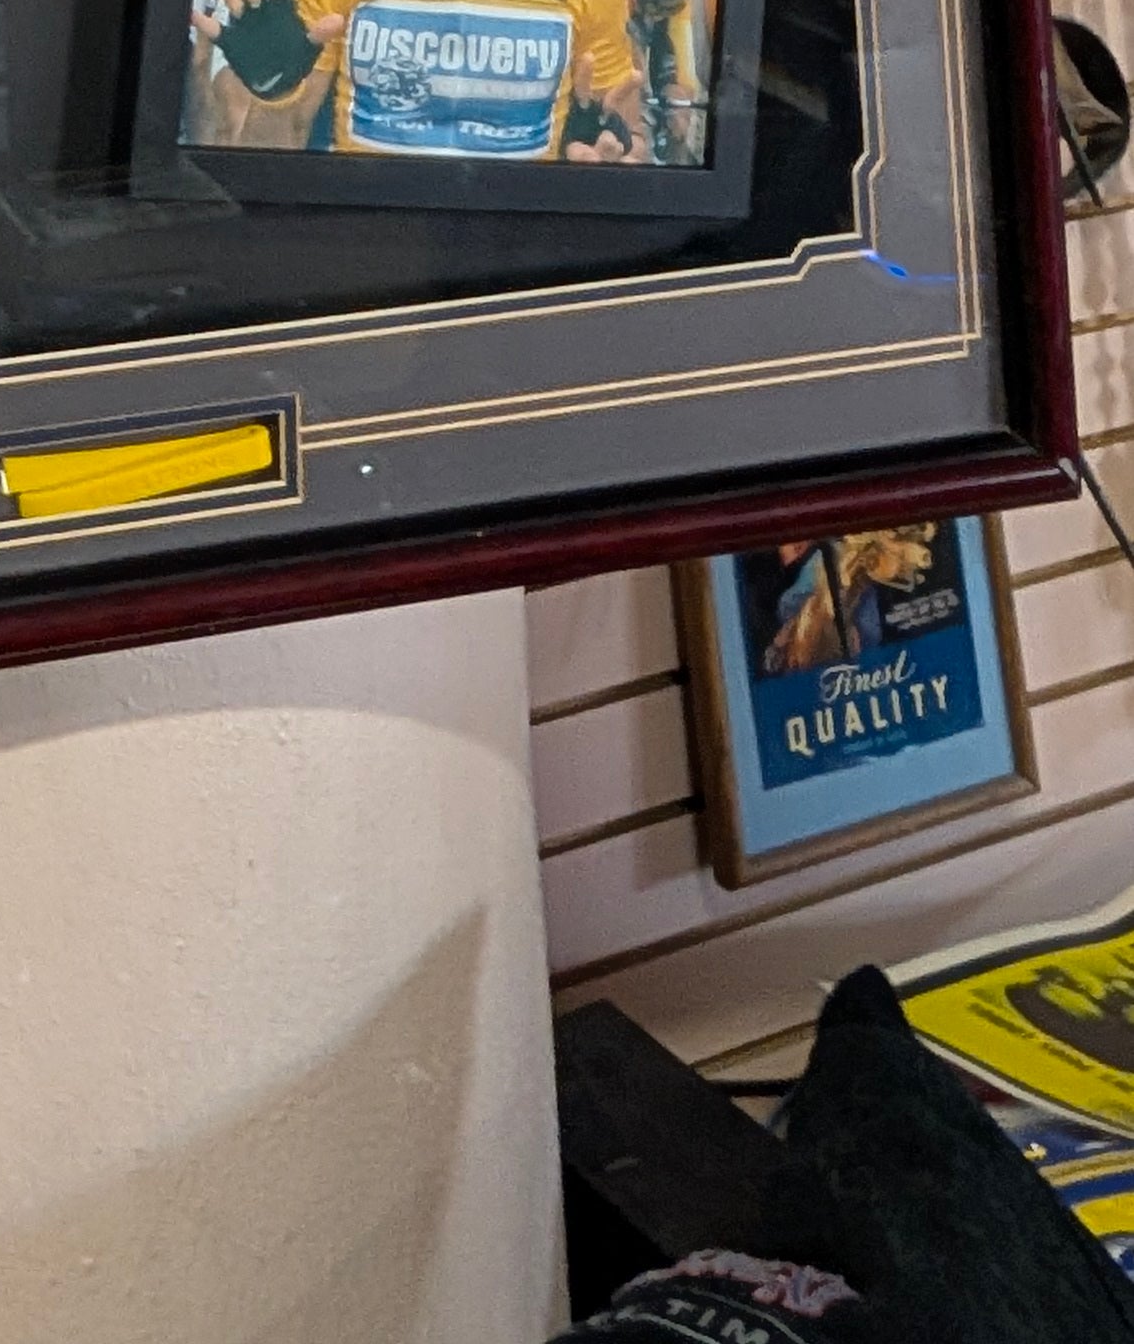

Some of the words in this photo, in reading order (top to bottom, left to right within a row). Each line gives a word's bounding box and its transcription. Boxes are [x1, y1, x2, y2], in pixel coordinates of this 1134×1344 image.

[351, 19, 560, 80] Discovery
[819, 649, 918, 704] Finest
[786, 674, 950, 758] QUALITY
